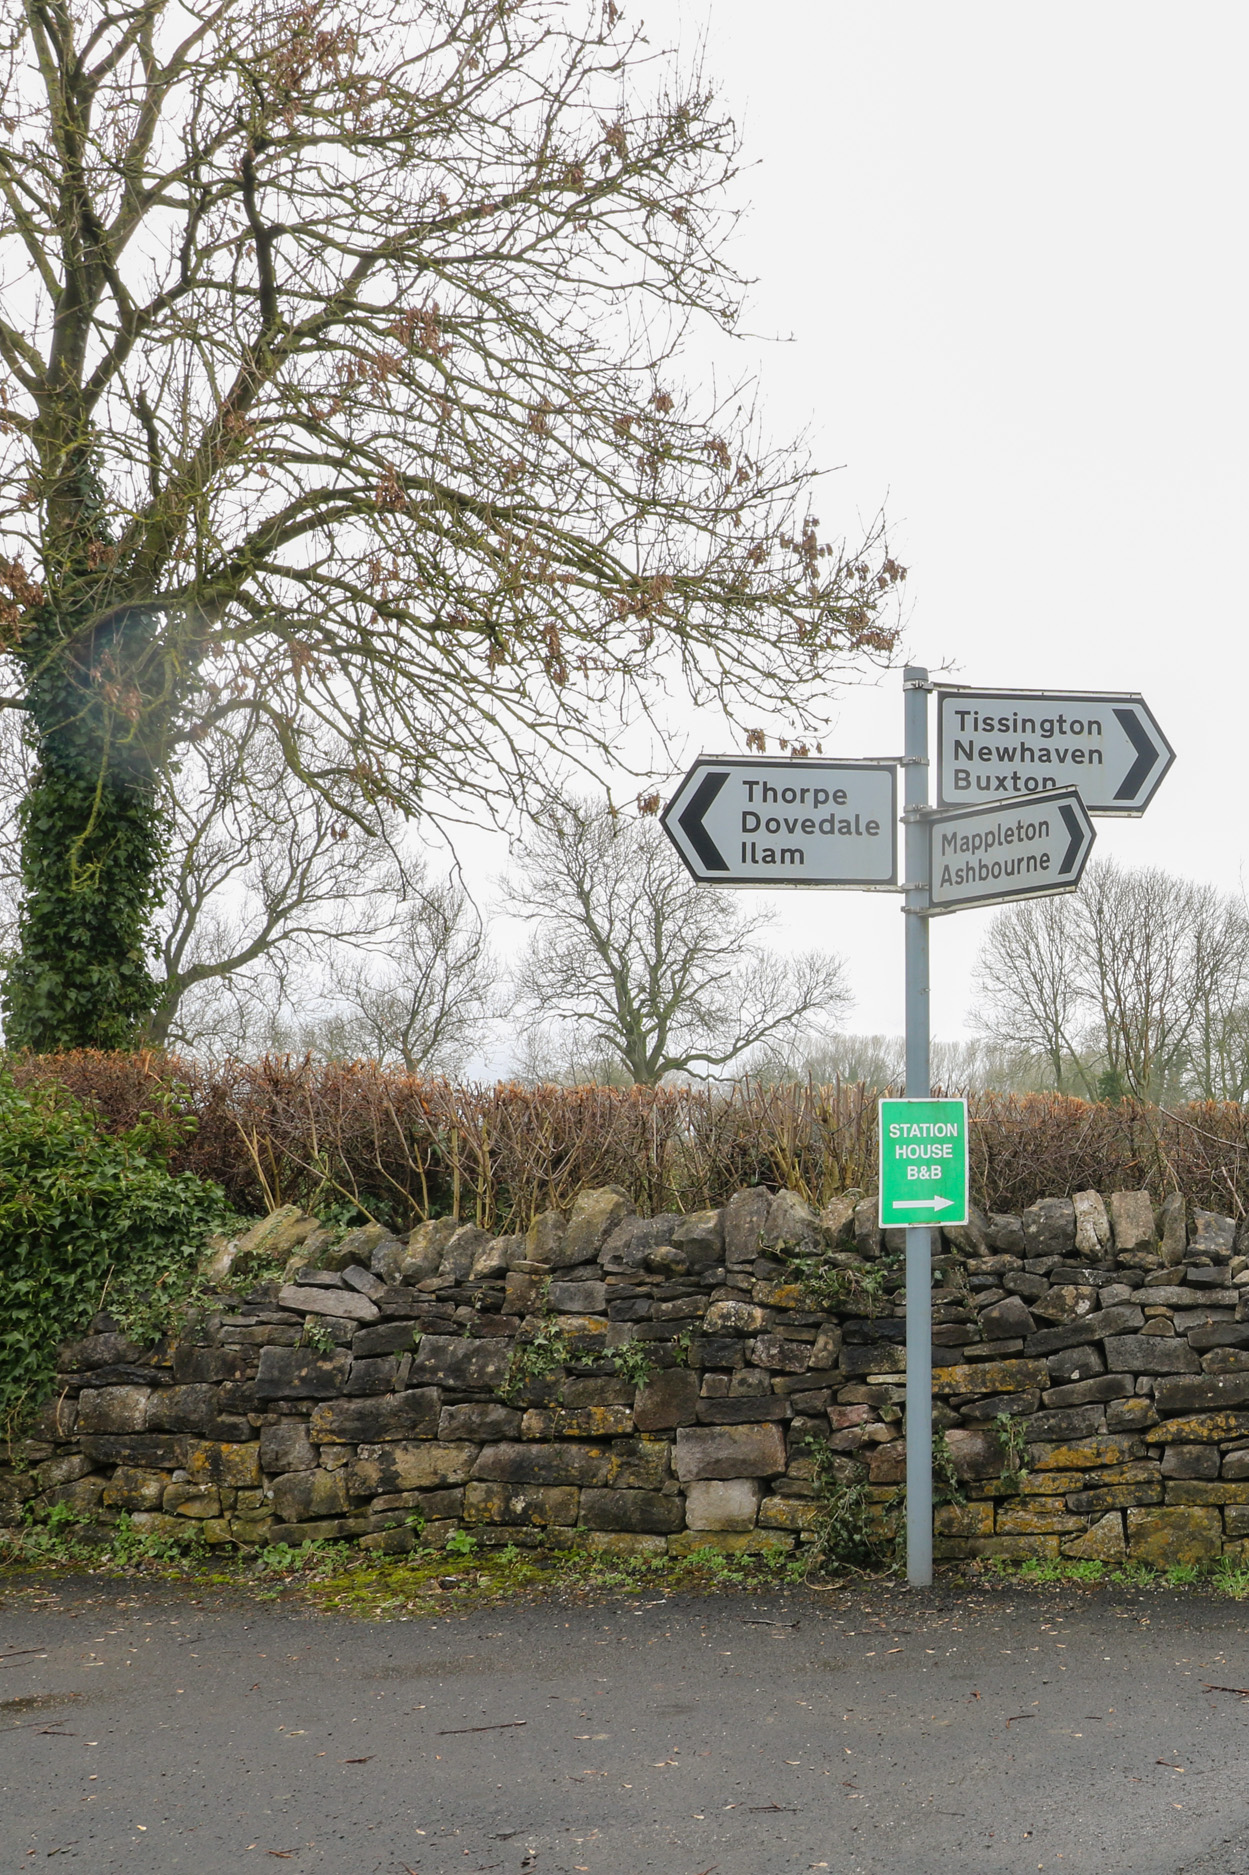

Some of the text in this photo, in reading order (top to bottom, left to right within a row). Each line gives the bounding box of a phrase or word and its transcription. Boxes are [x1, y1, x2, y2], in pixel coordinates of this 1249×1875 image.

[954, 710, 1102, 738] Tissington
[954, 740, 1103, 764] Newhaven
[954, 768, 1057, 792] Buxton
[742, 780, 848, 808] Thorpe
[741, 811, 880, 836] Dovedale
[941, 819, 1050, 857] Mappleton
[741, 841, 805, 865] Ilam
[940, 850, 1051, 887] Ashbourne
[889, 1123, 958, 1138] STATION
[895, 1144, 953, 1159] HOUSE
[907, 1165, 942, 1180] B&B
